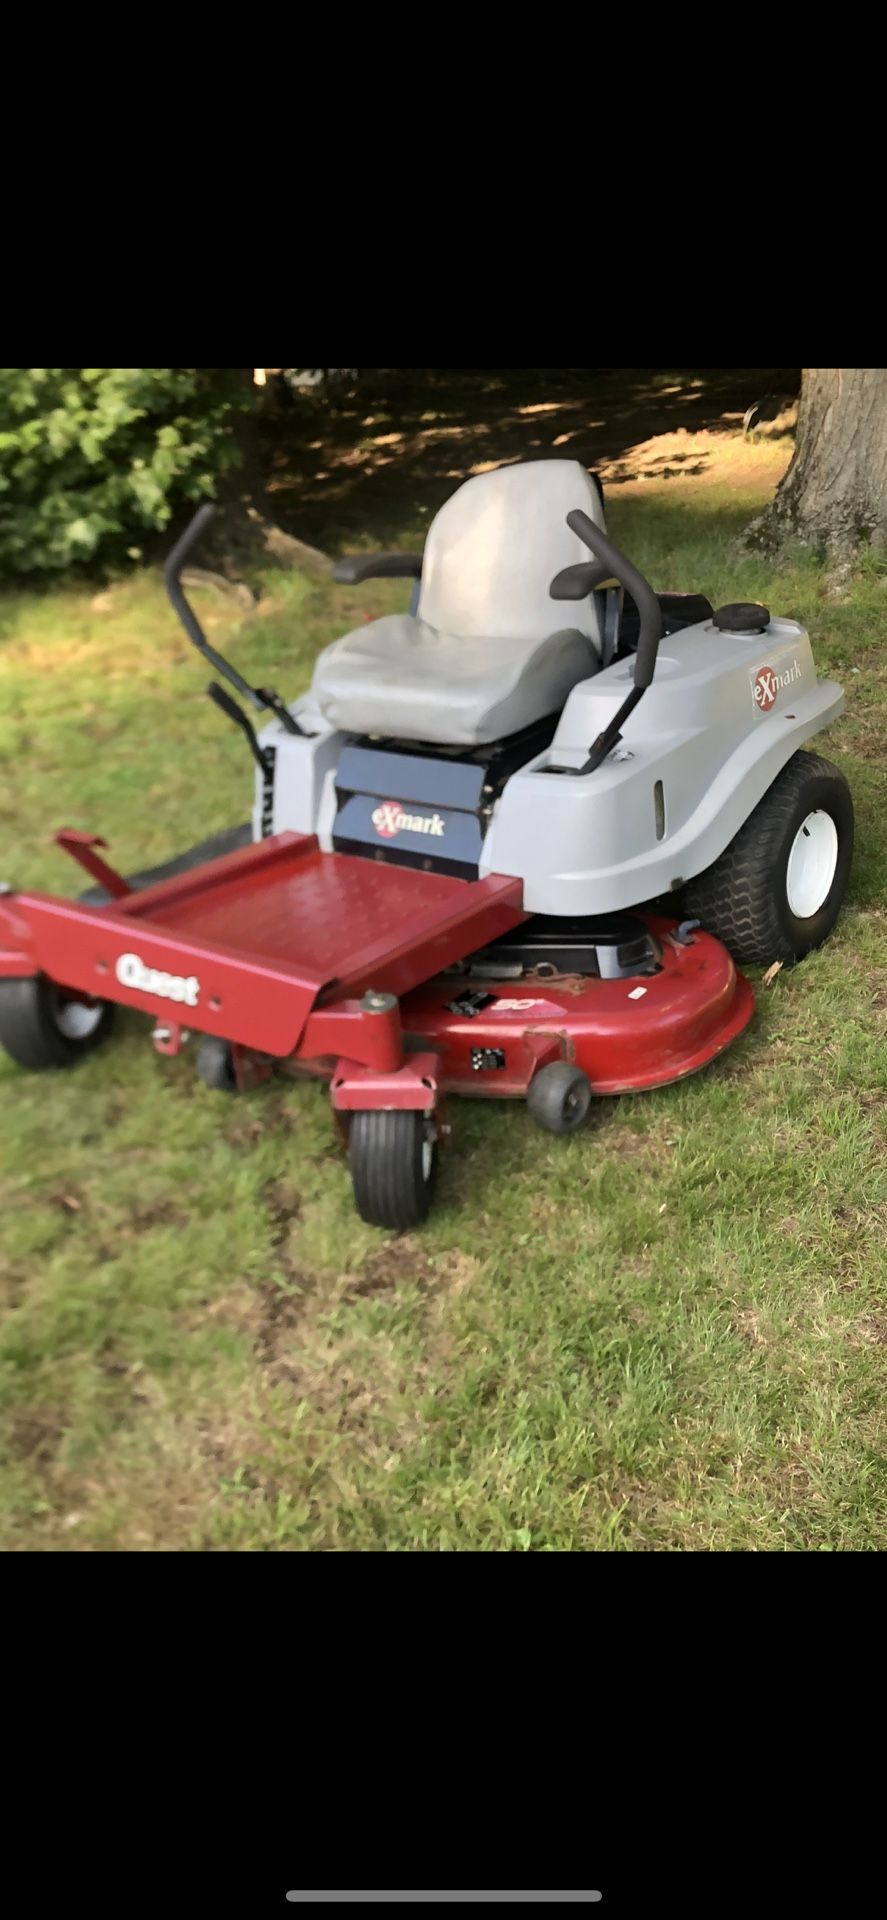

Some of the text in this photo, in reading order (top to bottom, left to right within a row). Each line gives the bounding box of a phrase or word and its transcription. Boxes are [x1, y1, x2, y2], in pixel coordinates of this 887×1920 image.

[754, 658, 802, 707] eXmark
[371, 803, 446, 837] eXmark
[115, 951, 201, 1007] Quest
